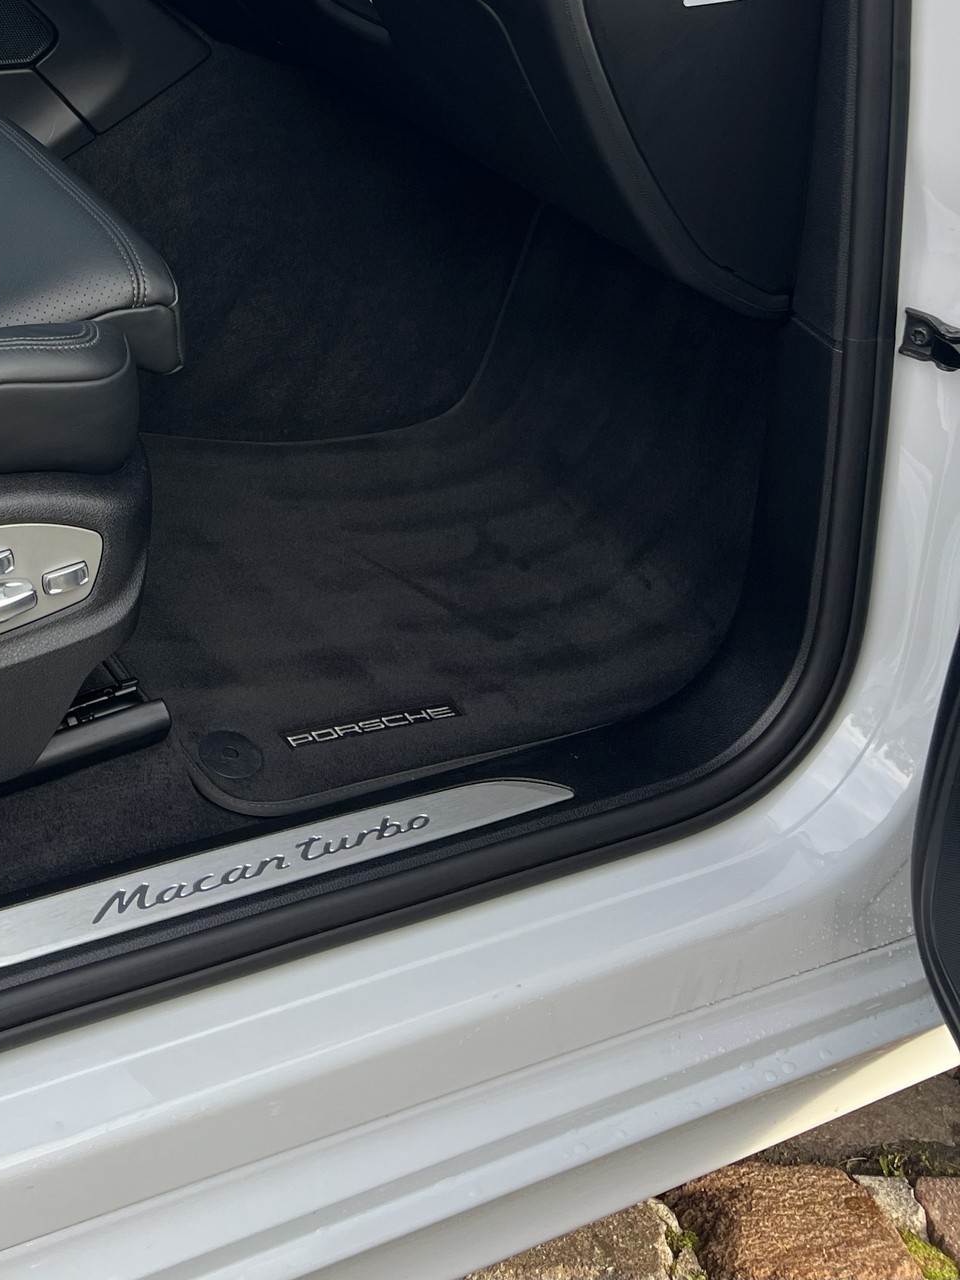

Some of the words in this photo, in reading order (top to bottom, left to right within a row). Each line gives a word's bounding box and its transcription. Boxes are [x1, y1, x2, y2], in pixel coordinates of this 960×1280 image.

[287, 706, 455, 747] PORSCHE
[92, 854, 290, 925] Macan
[295, 813, 431, 861] turbo
